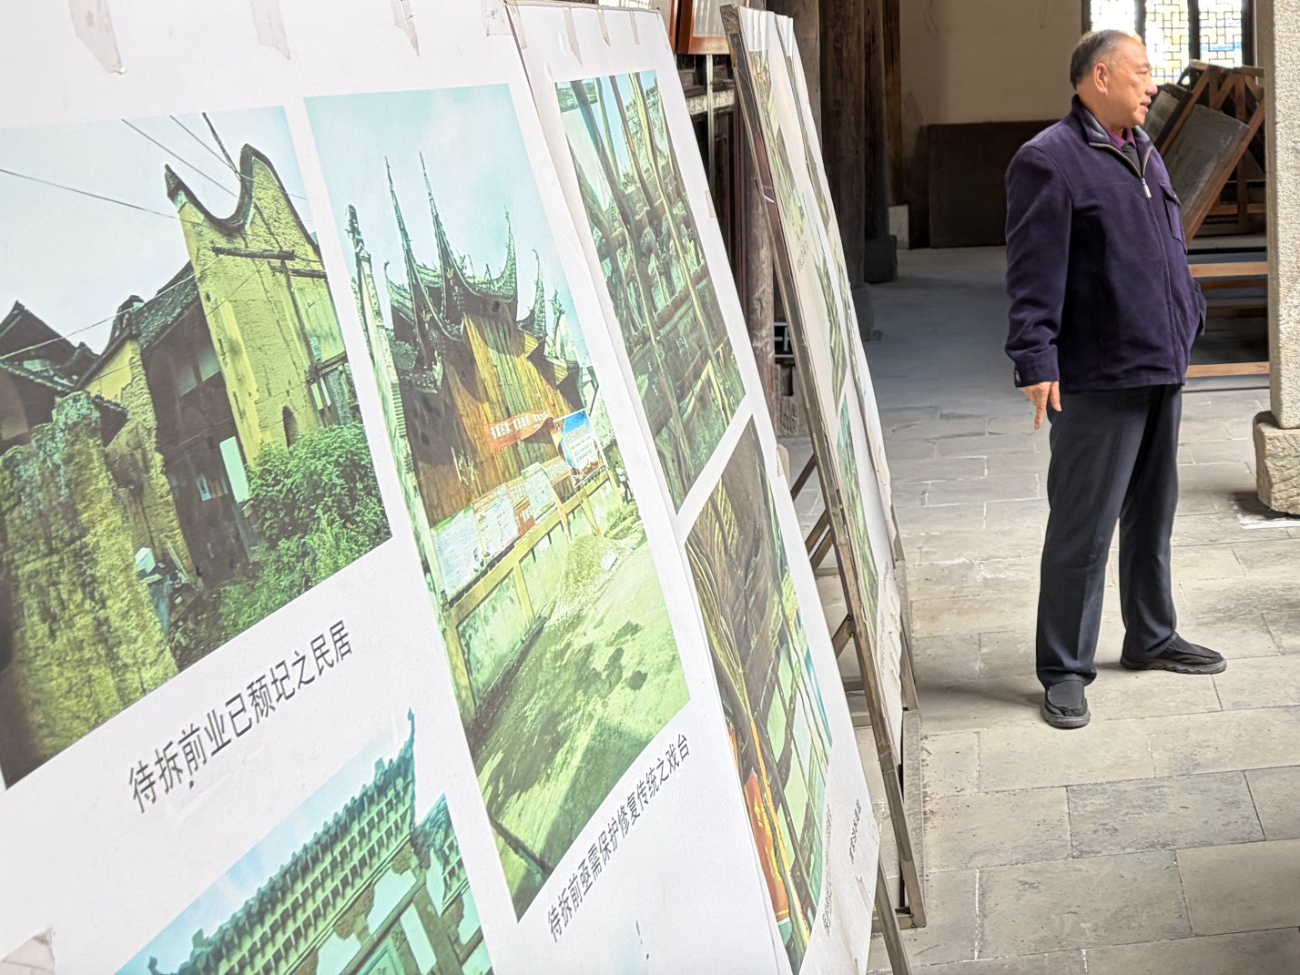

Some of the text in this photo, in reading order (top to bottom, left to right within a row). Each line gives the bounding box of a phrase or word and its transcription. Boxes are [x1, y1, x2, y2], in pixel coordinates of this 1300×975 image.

[129, 620, 352, 813] 待拆前业已颓圮之民居
